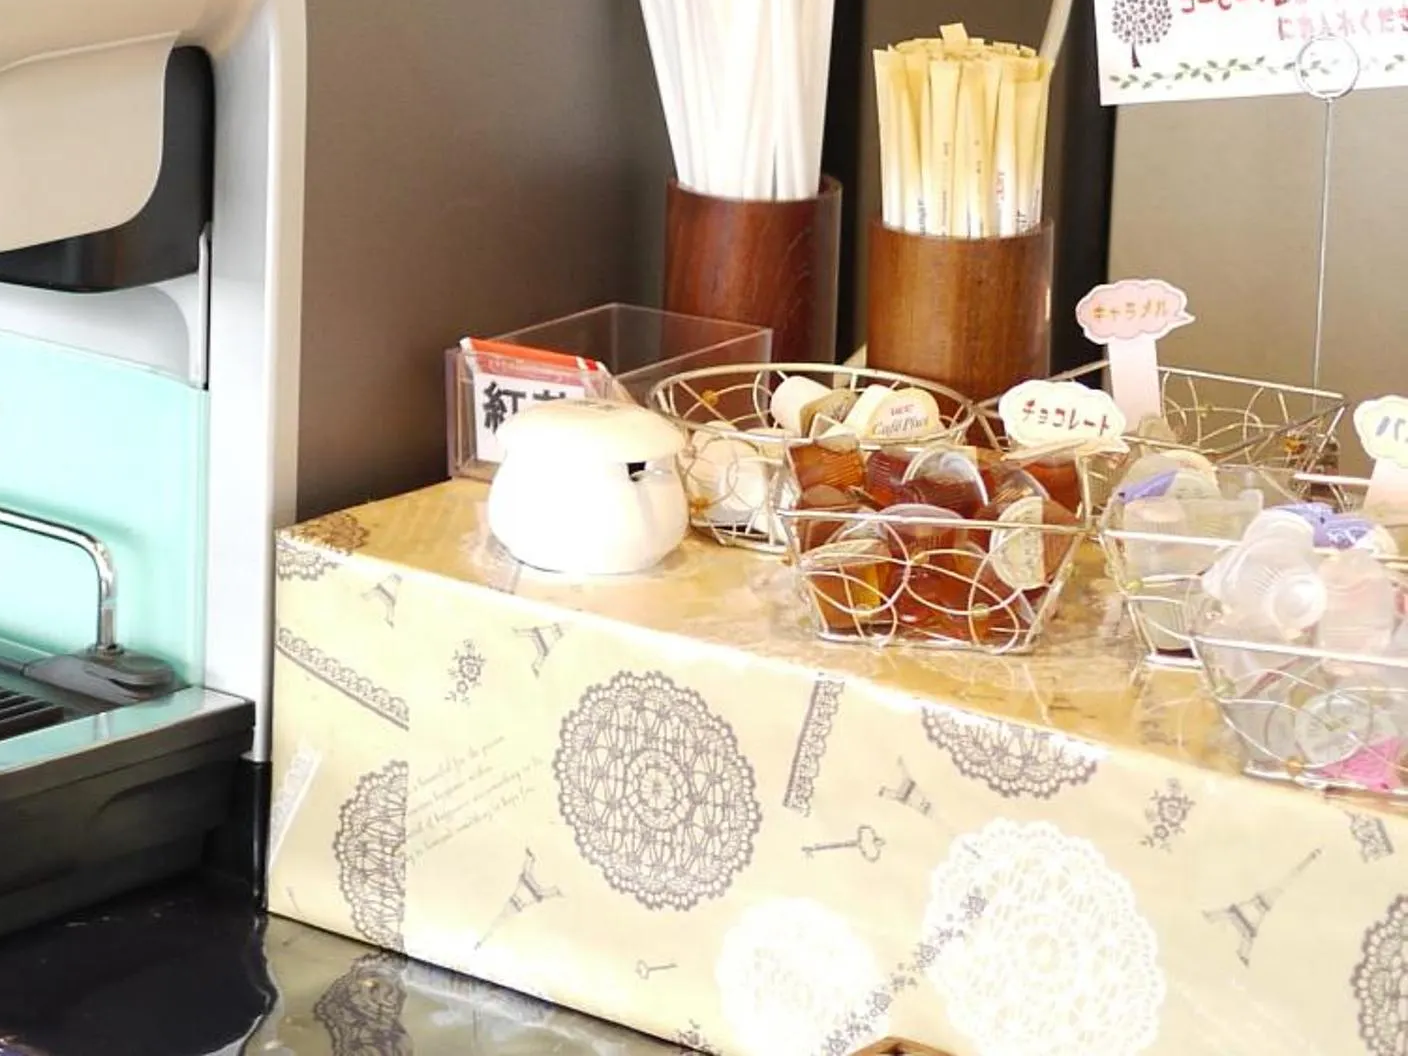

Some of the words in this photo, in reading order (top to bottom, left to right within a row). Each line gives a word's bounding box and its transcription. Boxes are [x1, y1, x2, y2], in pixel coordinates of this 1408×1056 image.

[1093, 297, 1168, 323] キャラメル
[483, 381, 567, 434] 紅
[1021, 399, 1111, 437] チョコレート
